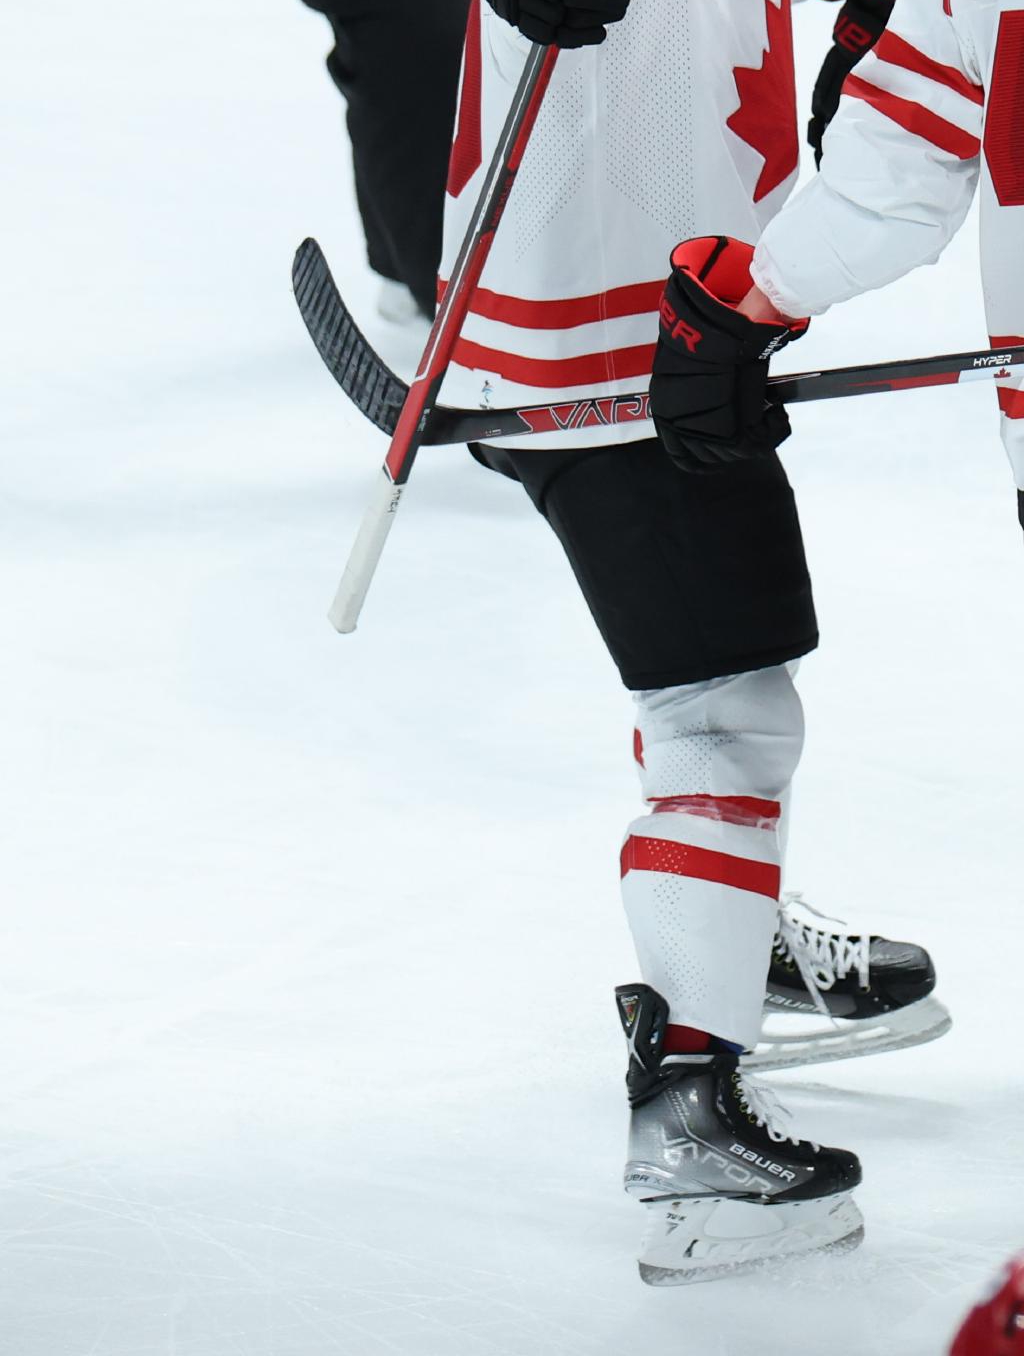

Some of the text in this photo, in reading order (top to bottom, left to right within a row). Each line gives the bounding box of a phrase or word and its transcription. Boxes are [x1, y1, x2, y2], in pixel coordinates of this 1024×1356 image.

[973, 354, 1012, 367] HYPER
[661, 1124, 773, 1194] VAPOR
[729, 1143, 797, 1183] BAUER
